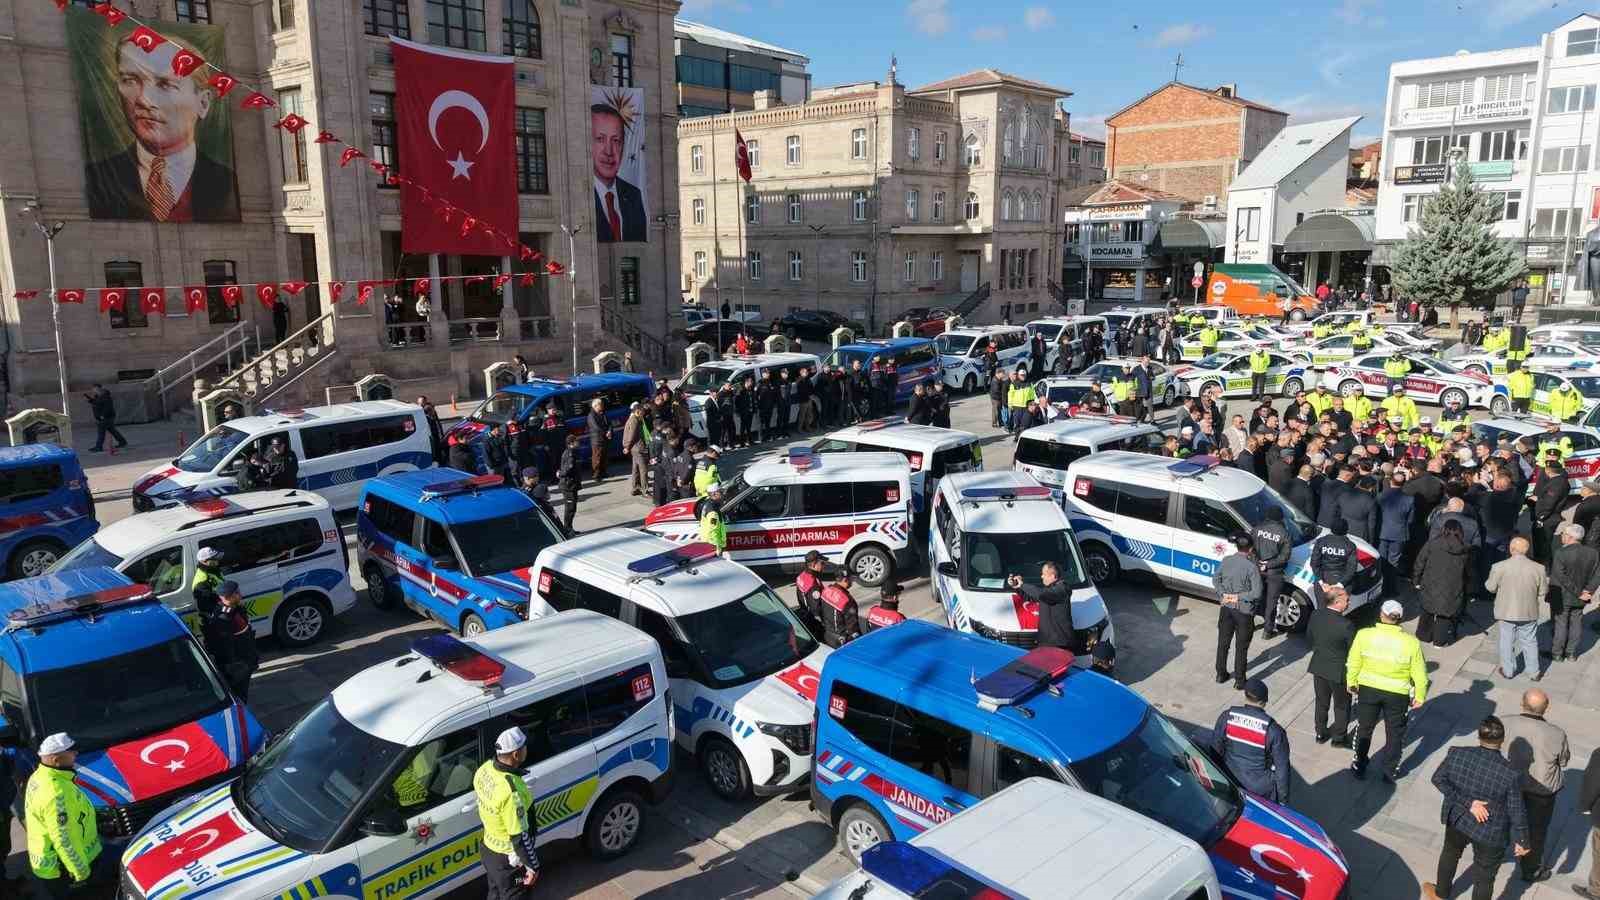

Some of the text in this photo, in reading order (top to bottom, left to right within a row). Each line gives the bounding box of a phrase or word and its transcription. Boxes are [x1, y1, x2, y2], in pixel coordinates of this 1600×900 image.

[1091, 247, 1133, 255] KOCAMAN
[729, 530, 839, 546] TRAFİK JANDARMASI
[540, 574, 550, 585] 112
[634, 677, 650, 690] 112
[832, 698, 845, 711] 112
[890, 786, 953, 823] JANDAR
[374, 838, 480, 900] TRAFİK POLİ
